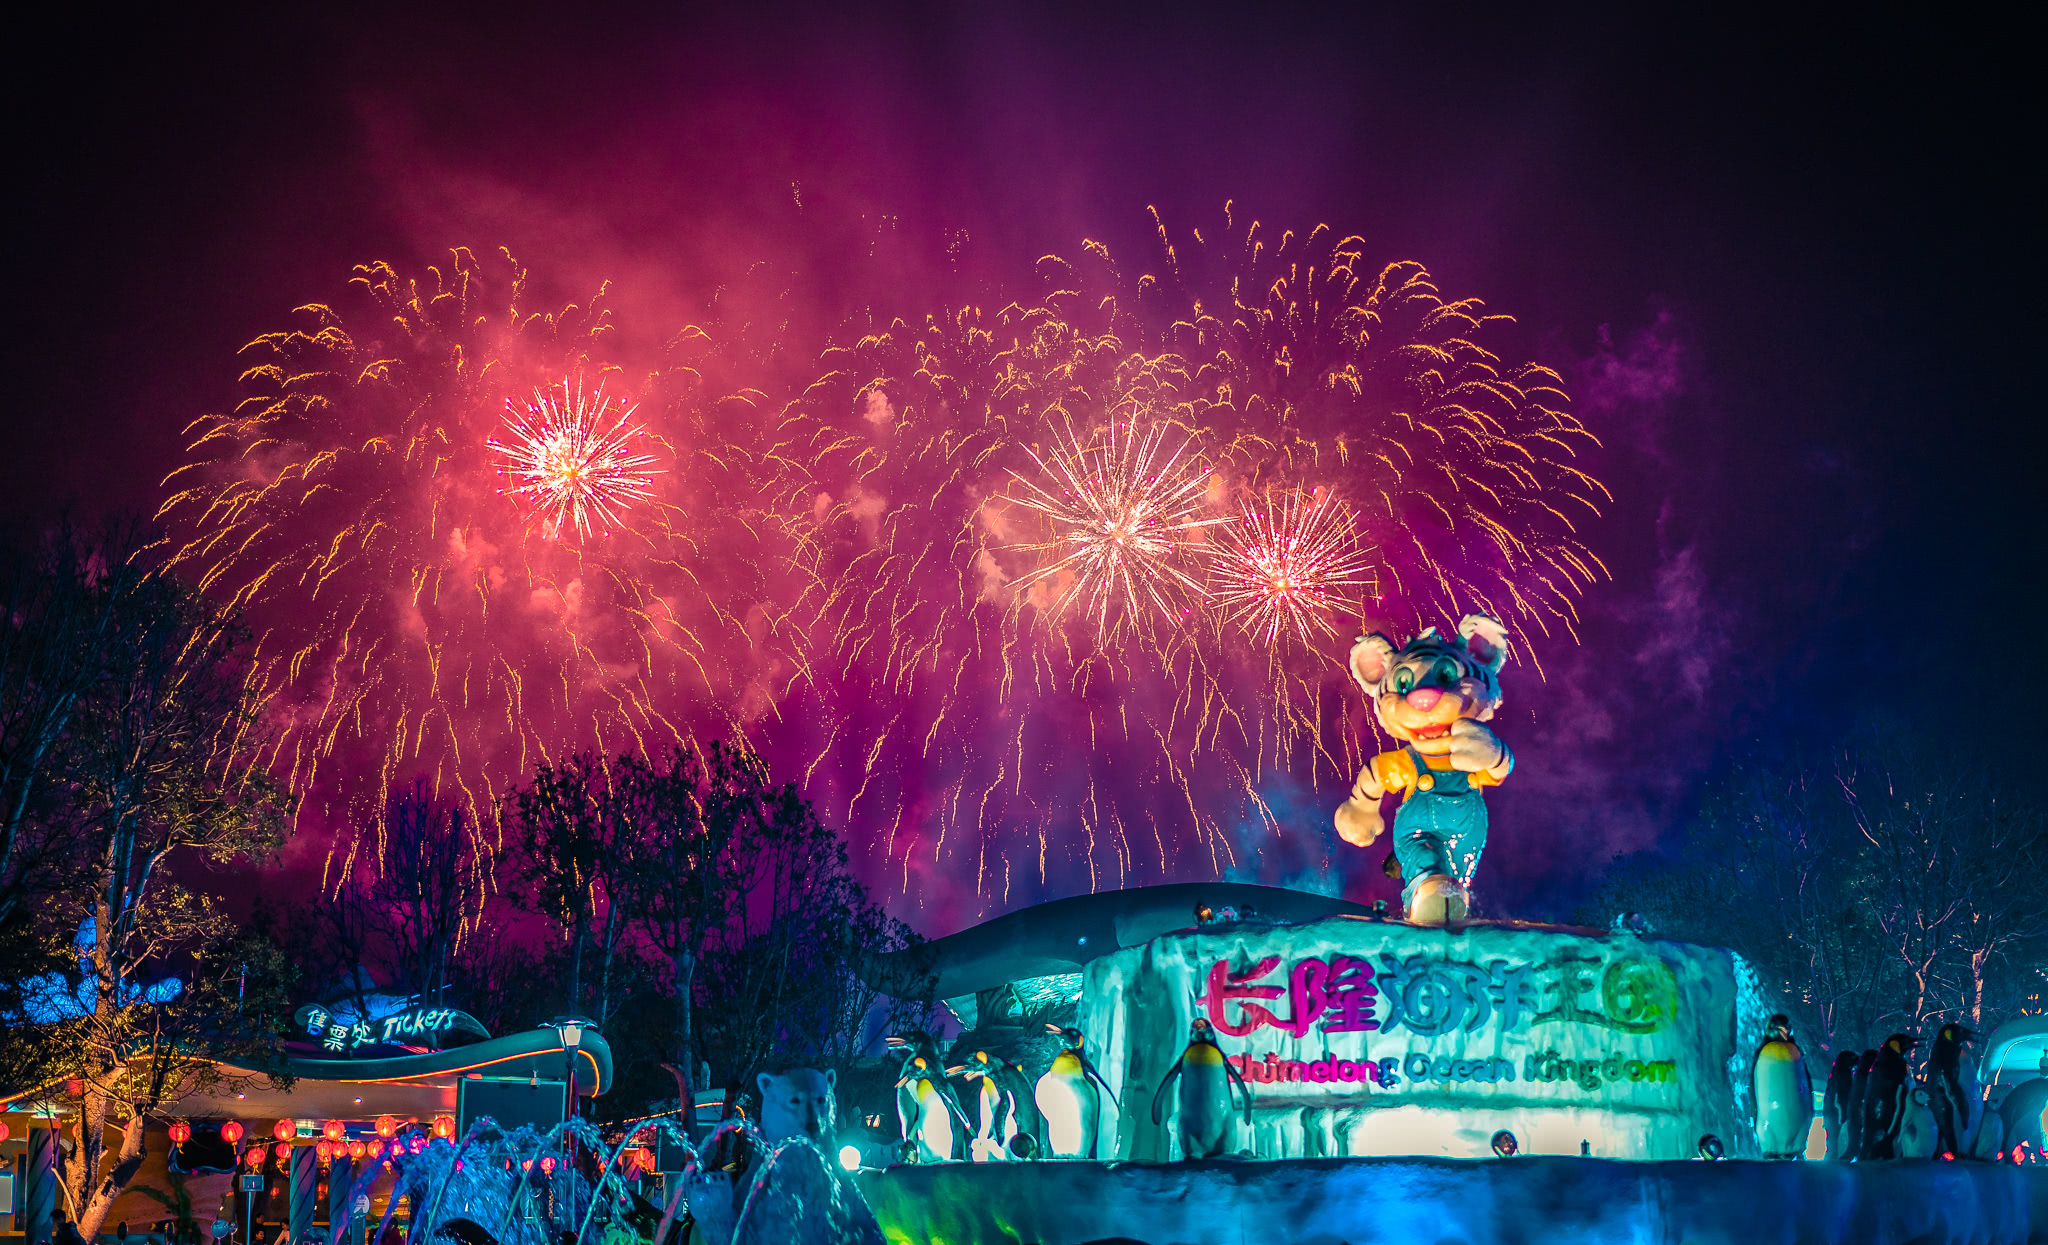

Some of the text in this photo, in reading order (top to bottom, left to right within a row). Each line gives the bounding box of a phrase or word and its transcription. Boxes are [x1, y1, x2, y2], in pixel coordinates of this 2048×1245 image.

[307, 1009, 377, 1052] 售票处
[382, 1008, 457, 1041] Tickets
[1404, 1052, 1516, 1084] Ocean
[1523, 1050, 1677, 1091] Kingdom
